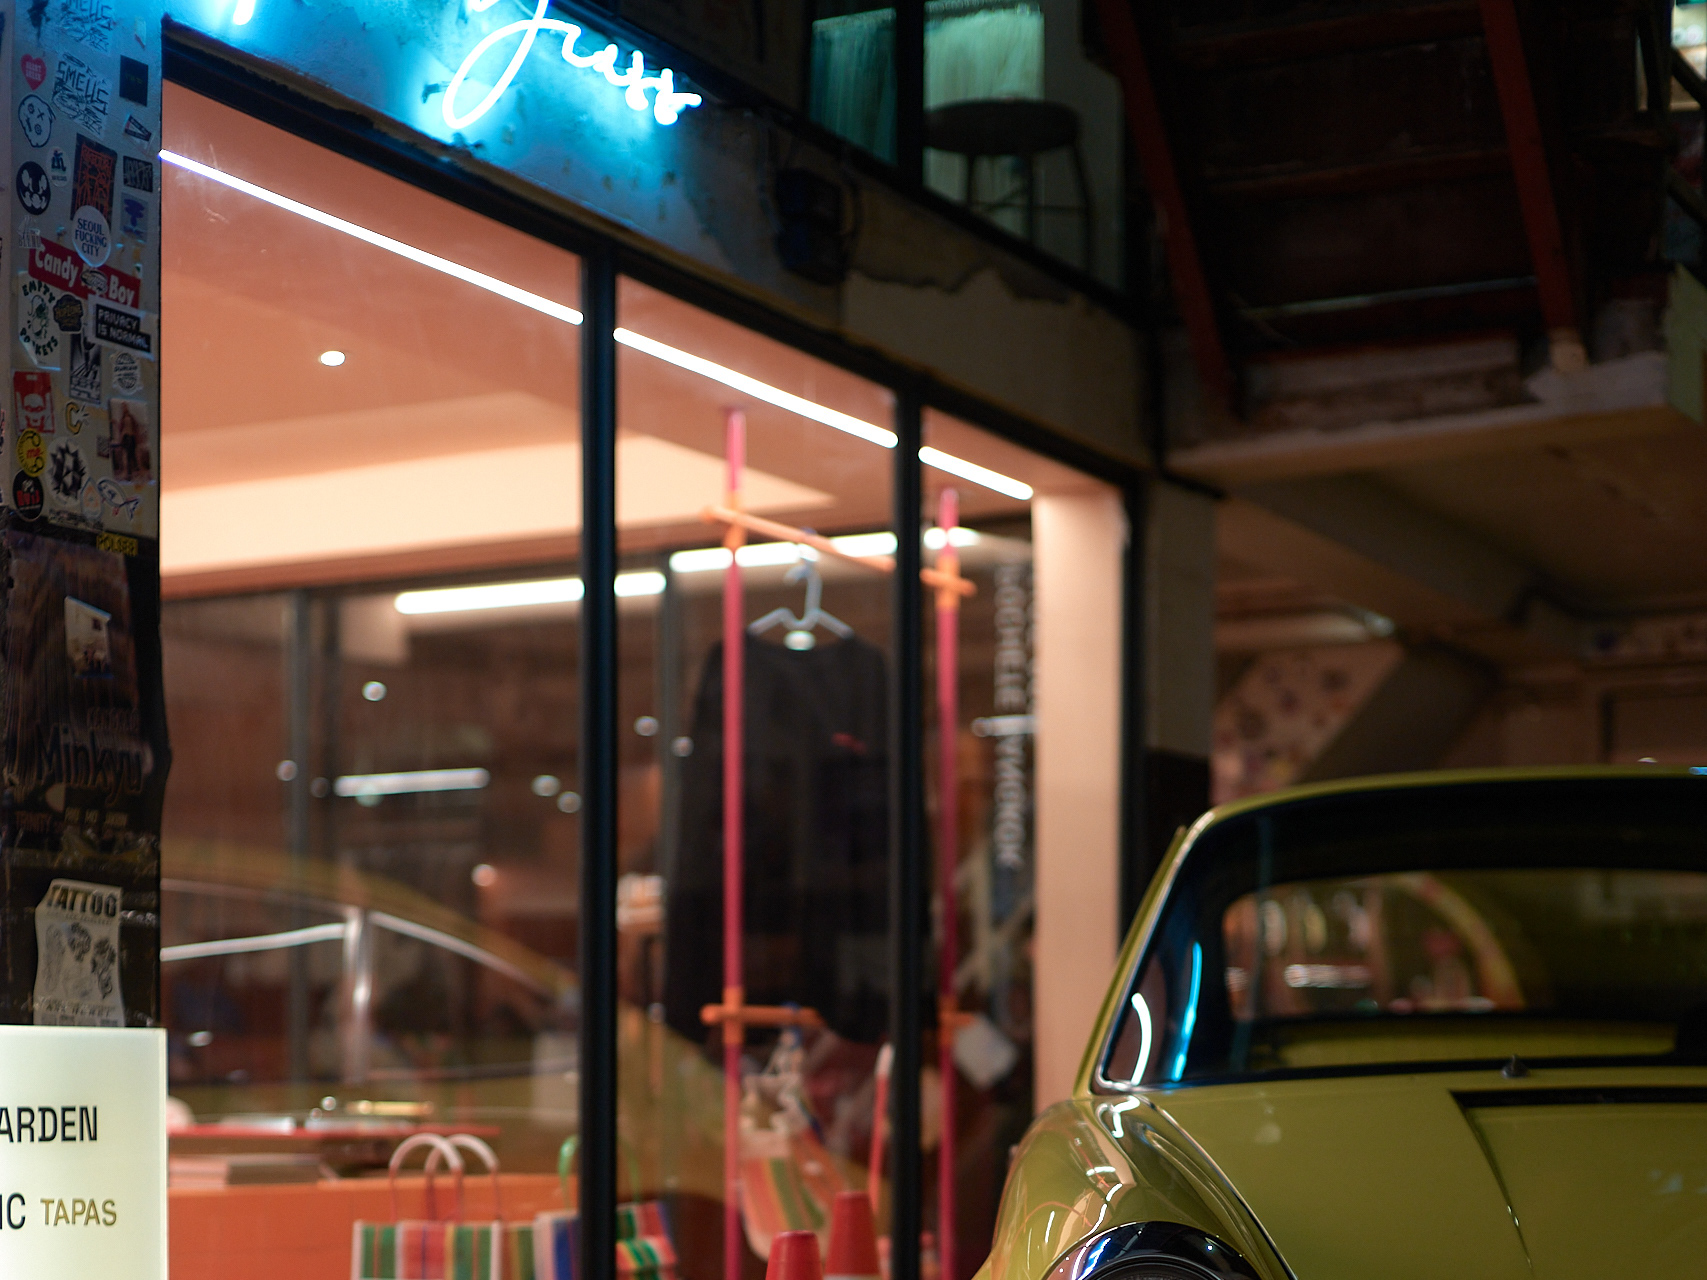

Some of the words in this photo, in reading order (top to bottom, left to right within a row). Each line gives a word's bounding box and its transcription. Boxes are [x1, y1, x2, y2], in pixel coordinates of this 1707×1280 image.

[77, 218, 103, 235] SEOUL
[75, 229, 107, 248] FUCKING
[81, 242, 100, 257] CITY
[35, 243, 79, 288] Candy
[109, 274, 134, 307] Boy
[22, 280, 55, 304] EMPTY
[40, 1198, 117, 1227] TAPAS
